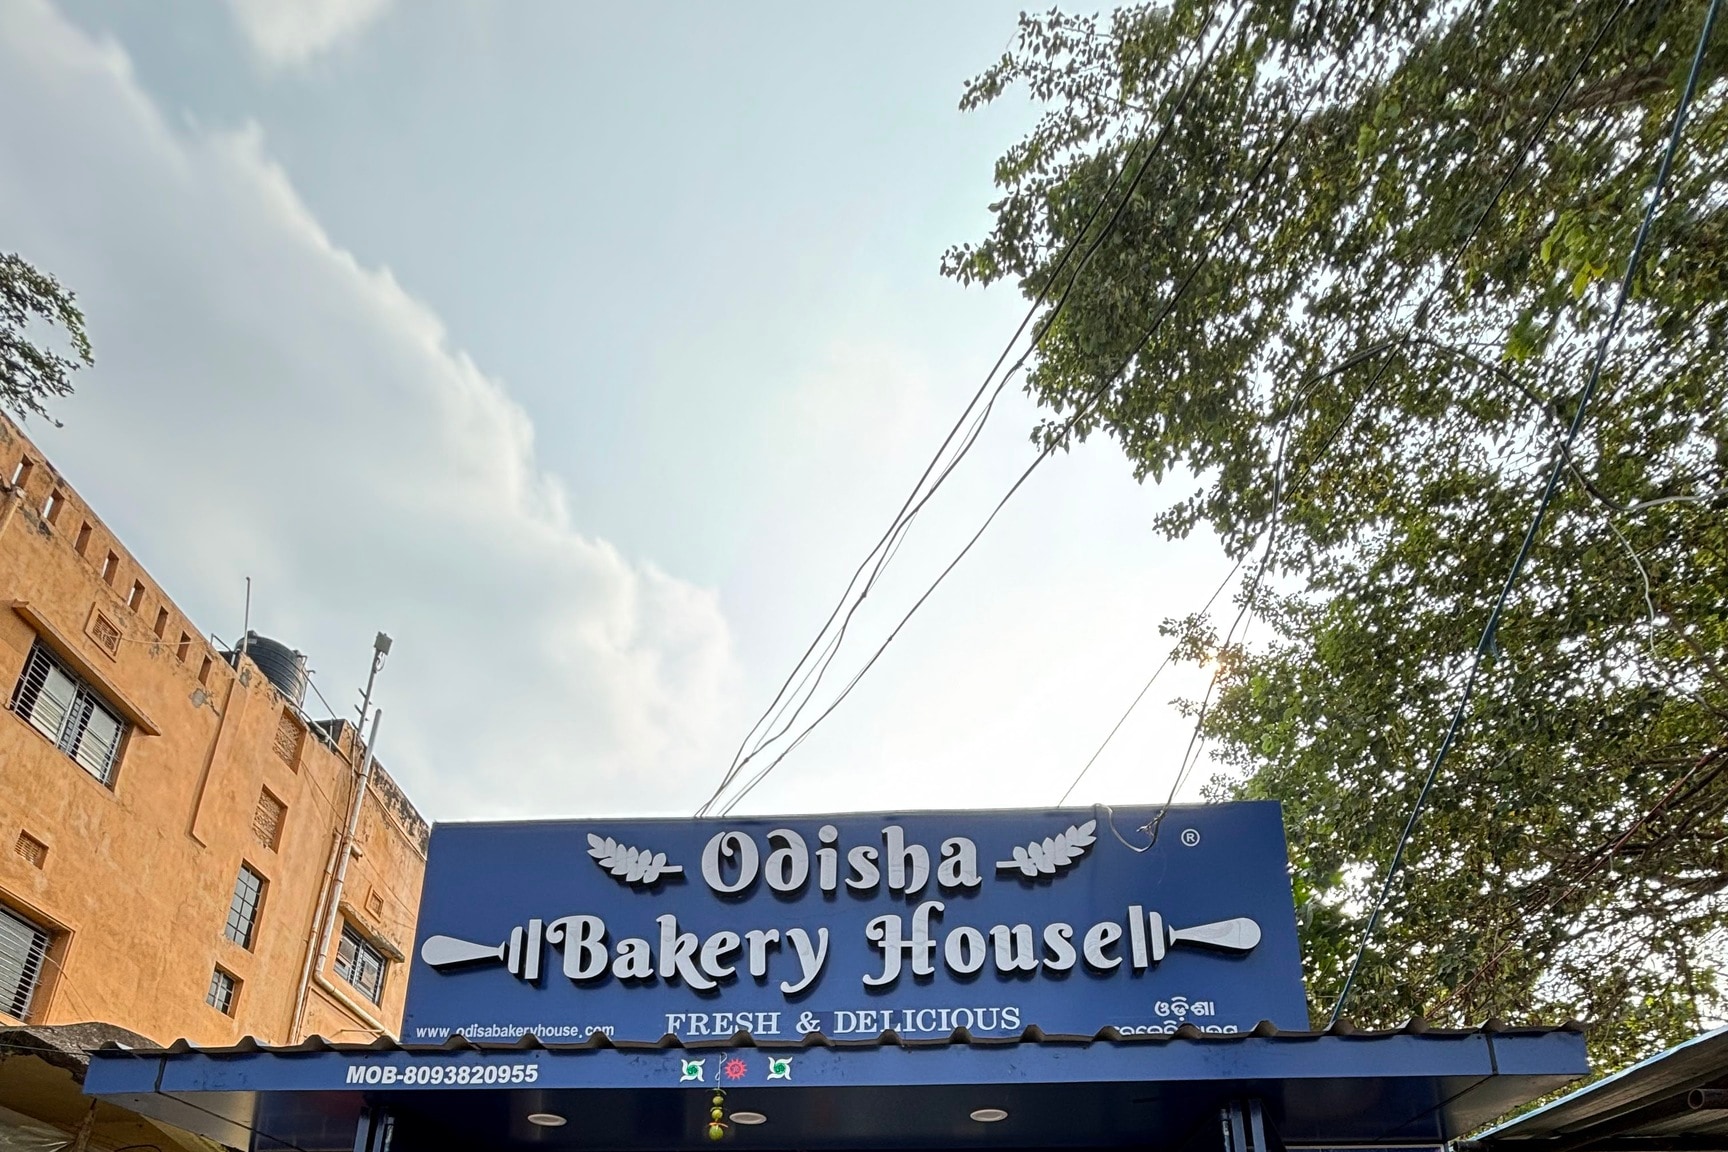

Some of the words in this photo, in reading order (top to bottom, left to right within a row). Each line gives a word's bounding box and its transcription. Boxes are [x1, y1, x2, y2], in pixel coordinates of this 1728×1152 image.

[701, 824, 982, 894] Odisha
[545, 913, 829, 994] Bakery
[862, 900, 1123, 987] House
[664, 1011, 782, 1035] FRESH
[796, 1010, 821, 1033] &
[834, 1007, 1021, 1033] DELICIOUS
[345, 1064, 539, 1084] MOB-8093820955
